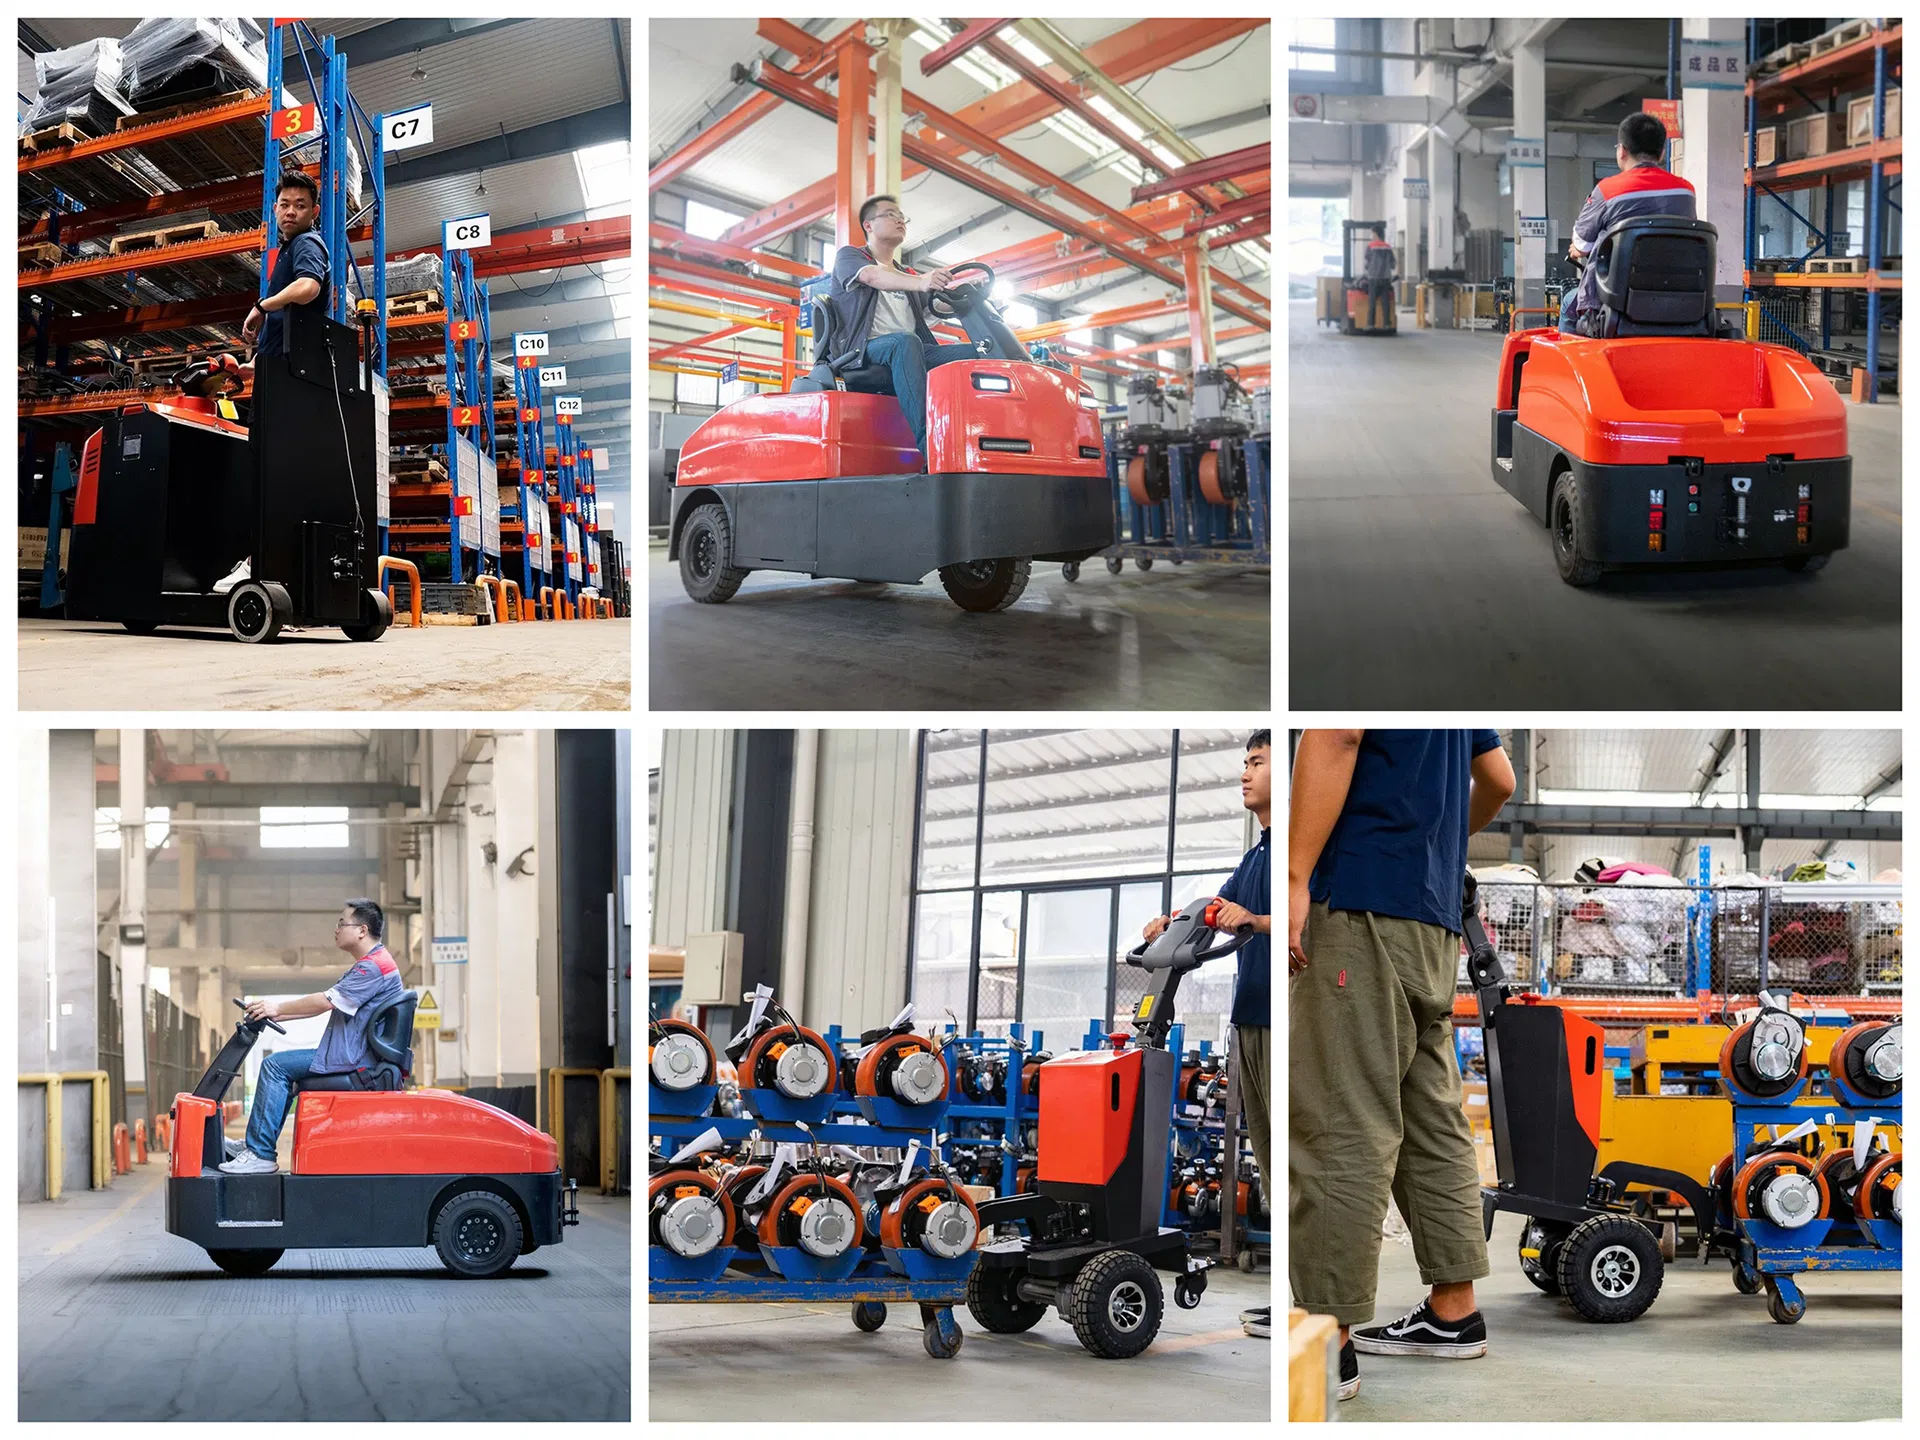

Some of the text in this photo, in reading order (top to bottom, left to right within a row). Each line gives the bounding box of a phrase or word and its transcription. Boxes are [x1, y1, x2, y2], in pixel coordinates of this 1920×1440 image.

[1689, 56, 1739, 73] 成品区
[285, 109, 302, 133] 3
[391, 118, 420, 139] C7
[456, 225, 480, 240] C8
[458, 323, 469, 338] 3
[520, 339, 545, 350] C10
[522, 357, 532, 367] 4
[541, 371, 563, 382] C11
[559, 401, 579, 410] C12
[460, 408, 472, 424] 2
[526, 409, 534, 421] 3
[561, 415, 569, 424] 4
[582, 450, 590, 458] 4
[564, 456, 572, 465] 3
[529, 470, 538, 483] 2
[585, 485, 592, 493] 3
[463, 497, 472, 514] 1
[565, 503, 573, 513] 2
[588, 523, 595, 531] 2
[533, 534, 540, 547] 1
[571, 553, 577, 562] 1
